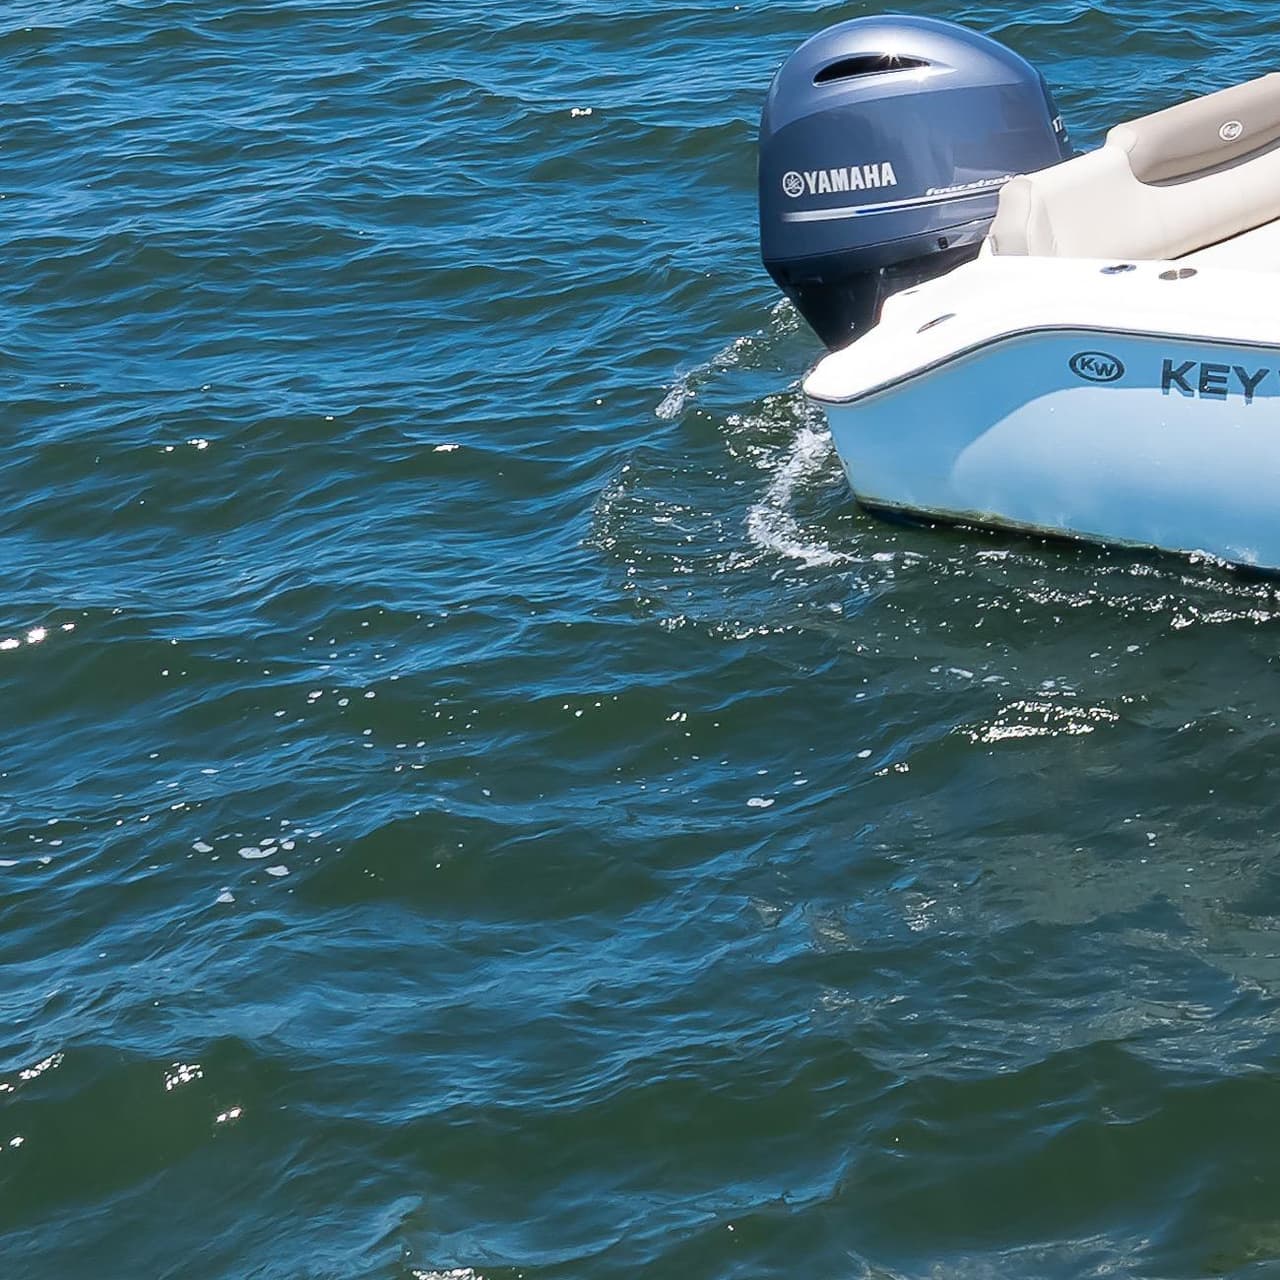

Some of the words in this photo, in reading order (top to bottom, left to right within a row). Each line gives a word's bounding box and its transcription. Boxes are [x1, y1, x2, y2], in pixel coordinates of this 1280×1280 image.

[804, 161, 897, 195] YAMAHA
[1077, 355, 1118, 378] KW
[1161, 358, 1270, 402] KEY
